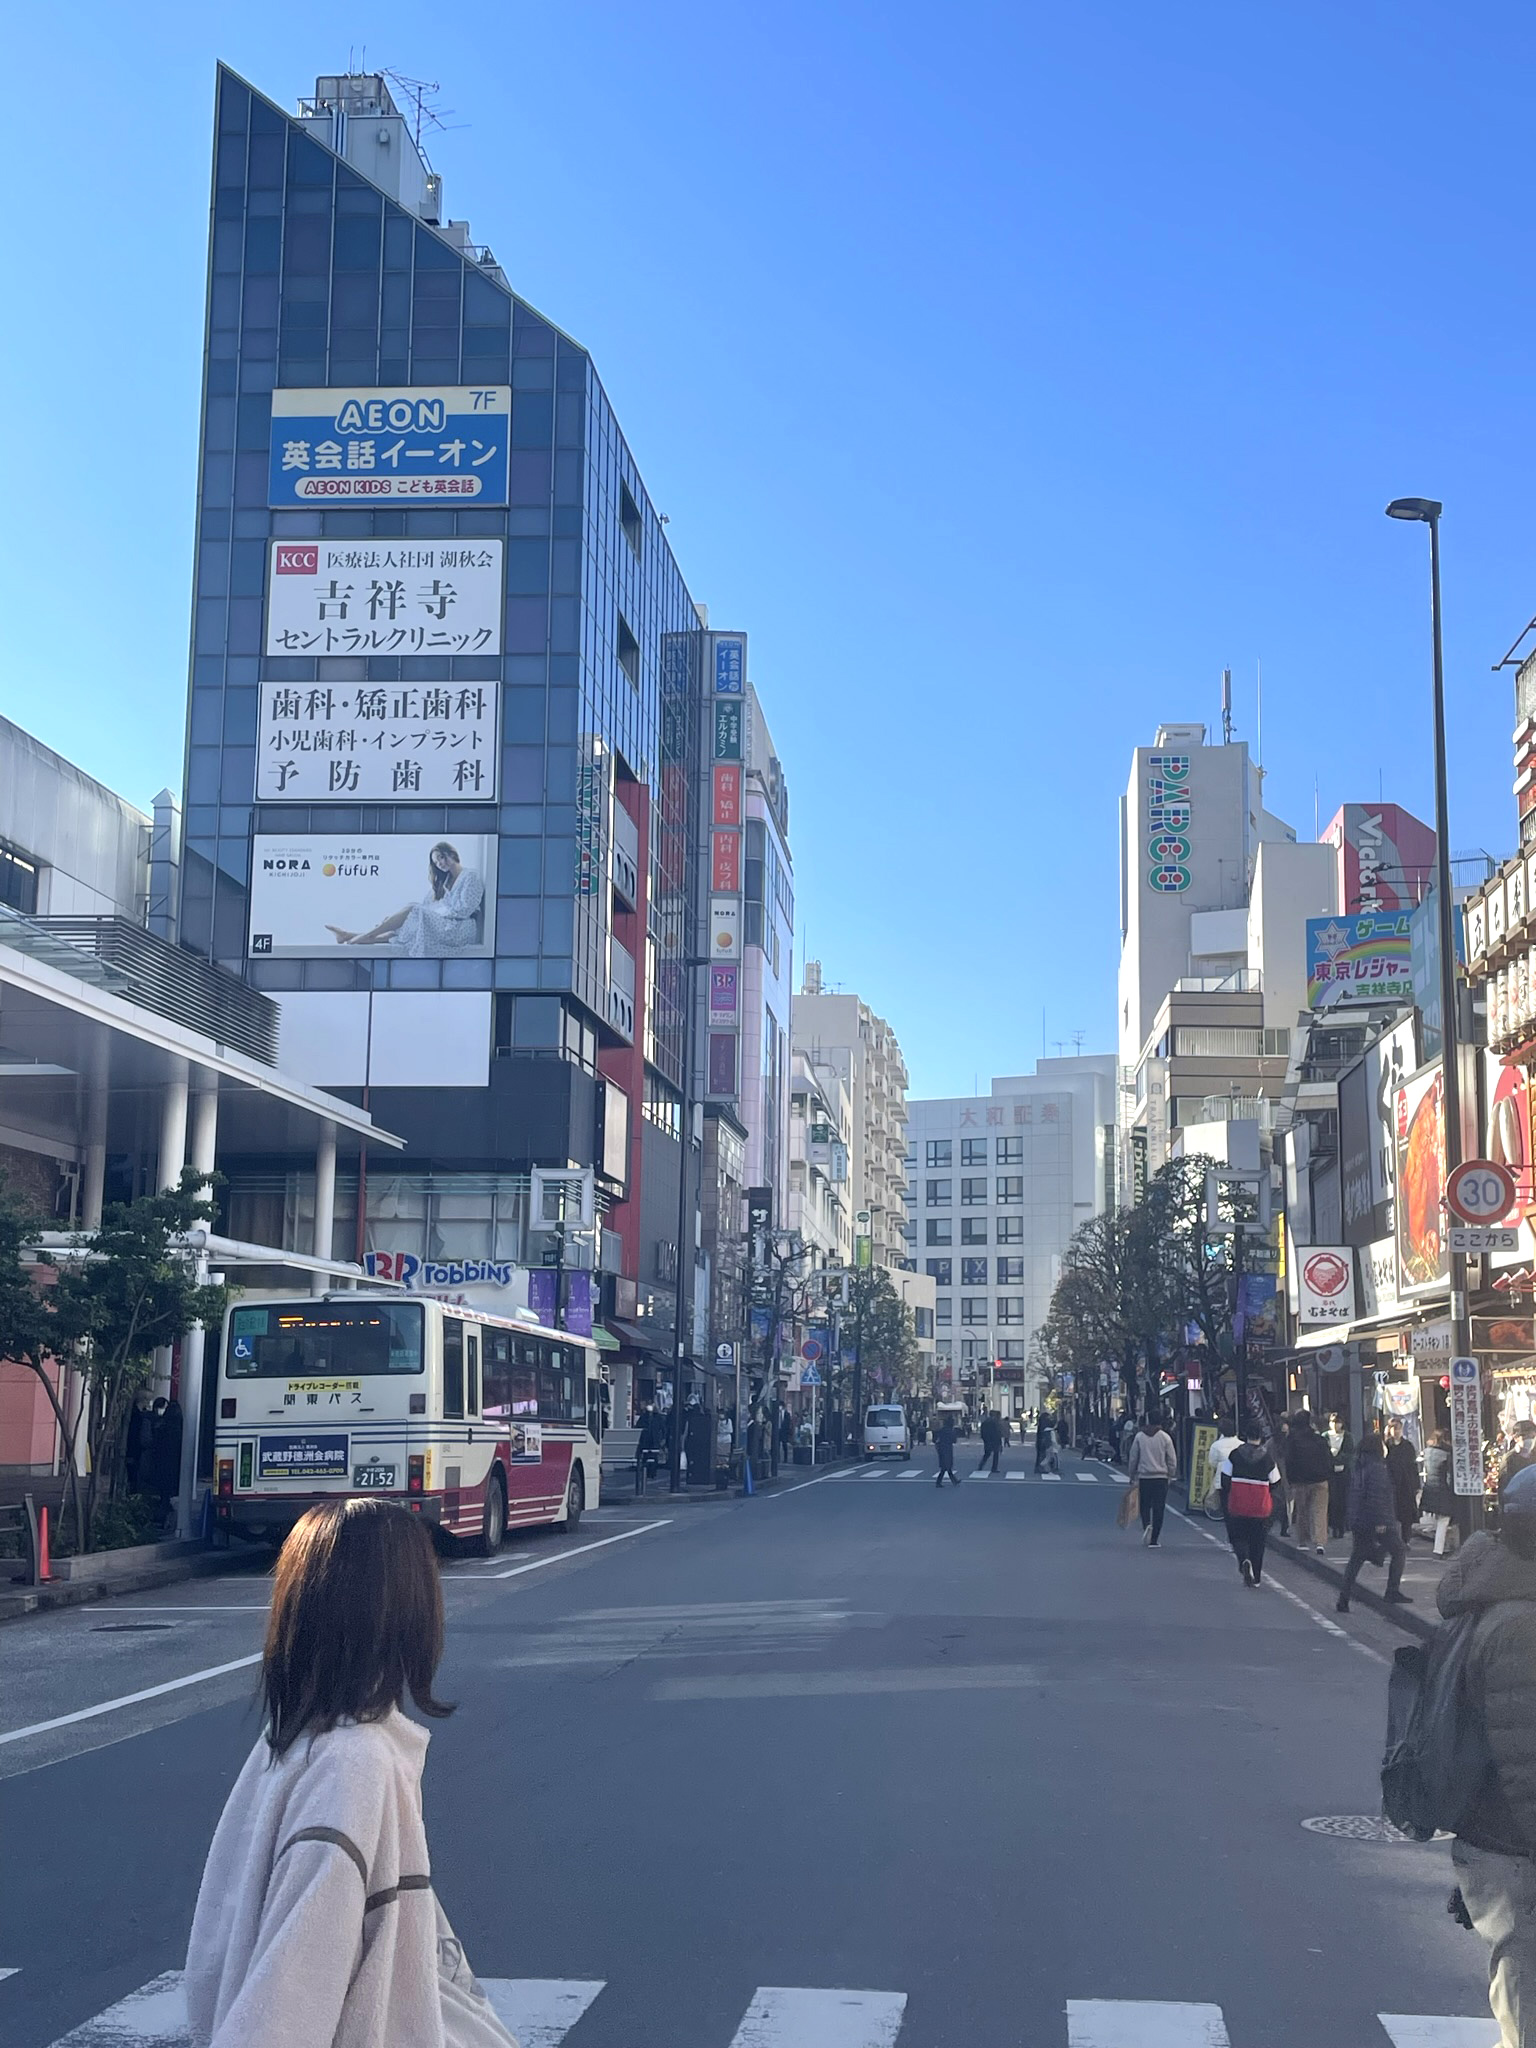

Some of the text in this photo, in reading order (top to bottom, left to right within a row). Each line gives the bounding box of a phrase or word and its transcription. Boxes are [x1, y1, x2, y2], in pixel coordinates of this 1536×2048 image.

[469, 391, 496, 410] 7F
[338, 401, 443, 430] AEON
[281, 439, 497, 471] 英会話イーオン
[304, 479, 474, 494] AEON KIDS こども英会話
[279, 552, 316, 568] KCC
[327, 550, 493, 568] 医療法人社団 湖秋会
[313, 580, 458, 621] 吉祥寺
[275, 627, 494, 653] セントラルクリニック
[717, 649, 729, 692] イーオン
[271, 687, 487, 722] 歯科・矯正歯科
[268, 728, 483, 752] 小児歯科・インプラント
[267, 759, 486, 793] 予防歯科
[1148, 755, 1193, 893] PARCO
[263, 859, 311, 870] NORA
[254, 938, 270, 949] 4F
[960, 1102, 1060, 1127] 大和証券
[1463, 1178, 1500, 1207] 30
[1453, 1233, 1514, 1247] ここから
[283, 1392, 363, 1406] 関東バス
[261, 1450, 345, 1463] 武蔵野徳洲会病院
